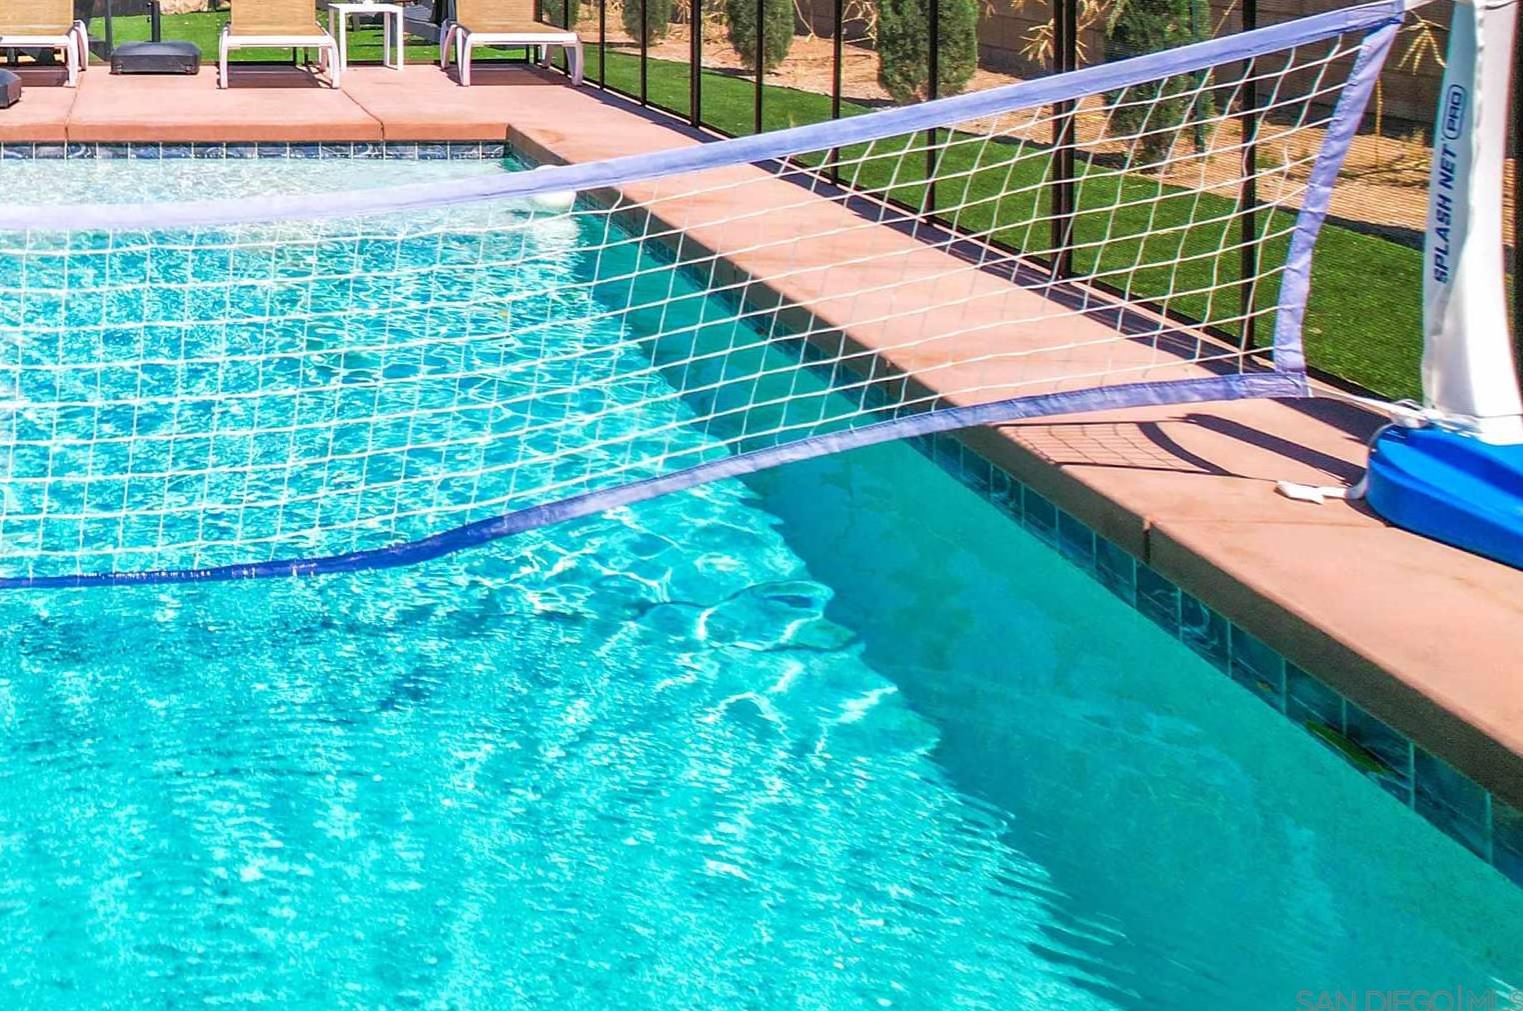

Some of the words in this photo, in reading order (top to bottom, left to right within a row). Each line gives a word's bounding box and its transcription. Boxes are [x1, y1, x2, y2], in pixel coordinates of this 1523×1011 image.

[1446, 91, 1462, 132] PRO
[1438, 143, 1457, 190] NET
[1434, 193, 1453, 284] SPLASH
